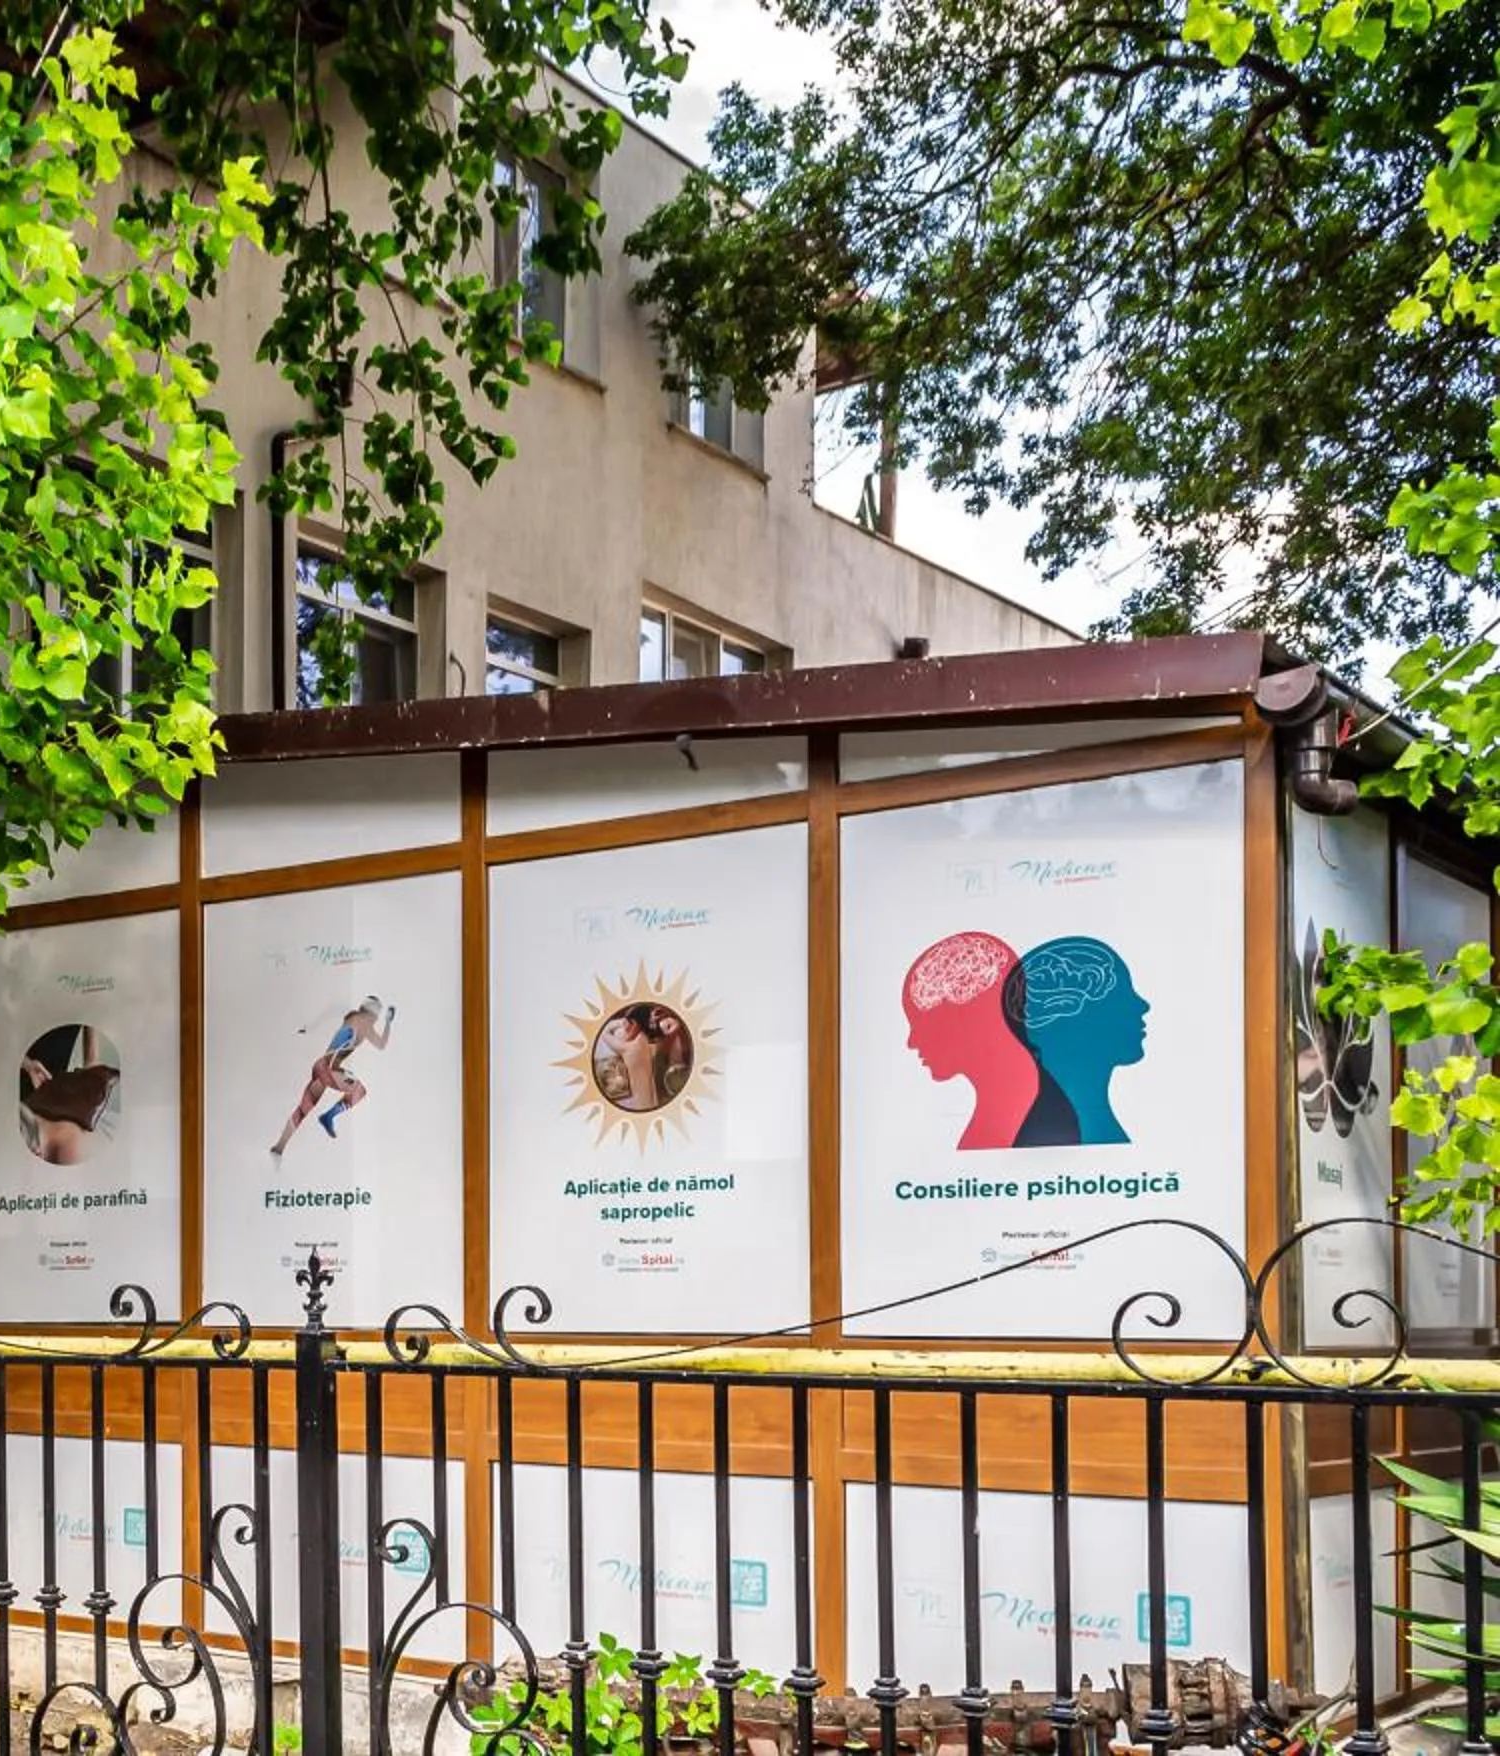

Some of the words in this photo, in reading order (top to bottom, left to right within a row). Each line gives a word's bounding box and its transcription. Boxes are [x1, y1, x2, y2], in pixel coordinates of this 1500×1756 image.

[564, 1177, 643, 1199] Aplicație
[647, 1177, 671, 1193] de
[676, 1174, 735, 1192] nămol
[895, 1178, 1020, 1200] Consiliere
[1027, 1171, 1180, 1201] psihologică
[1317, 1160, 1343, 1191] Masaj
[61, 1193, 79, 1209] de
[83, 1188, 148, 1210] parafină
[265, 1187, 372, 1210] Fizioterapie
[601, 1202, 695, 1222] sapropelic
